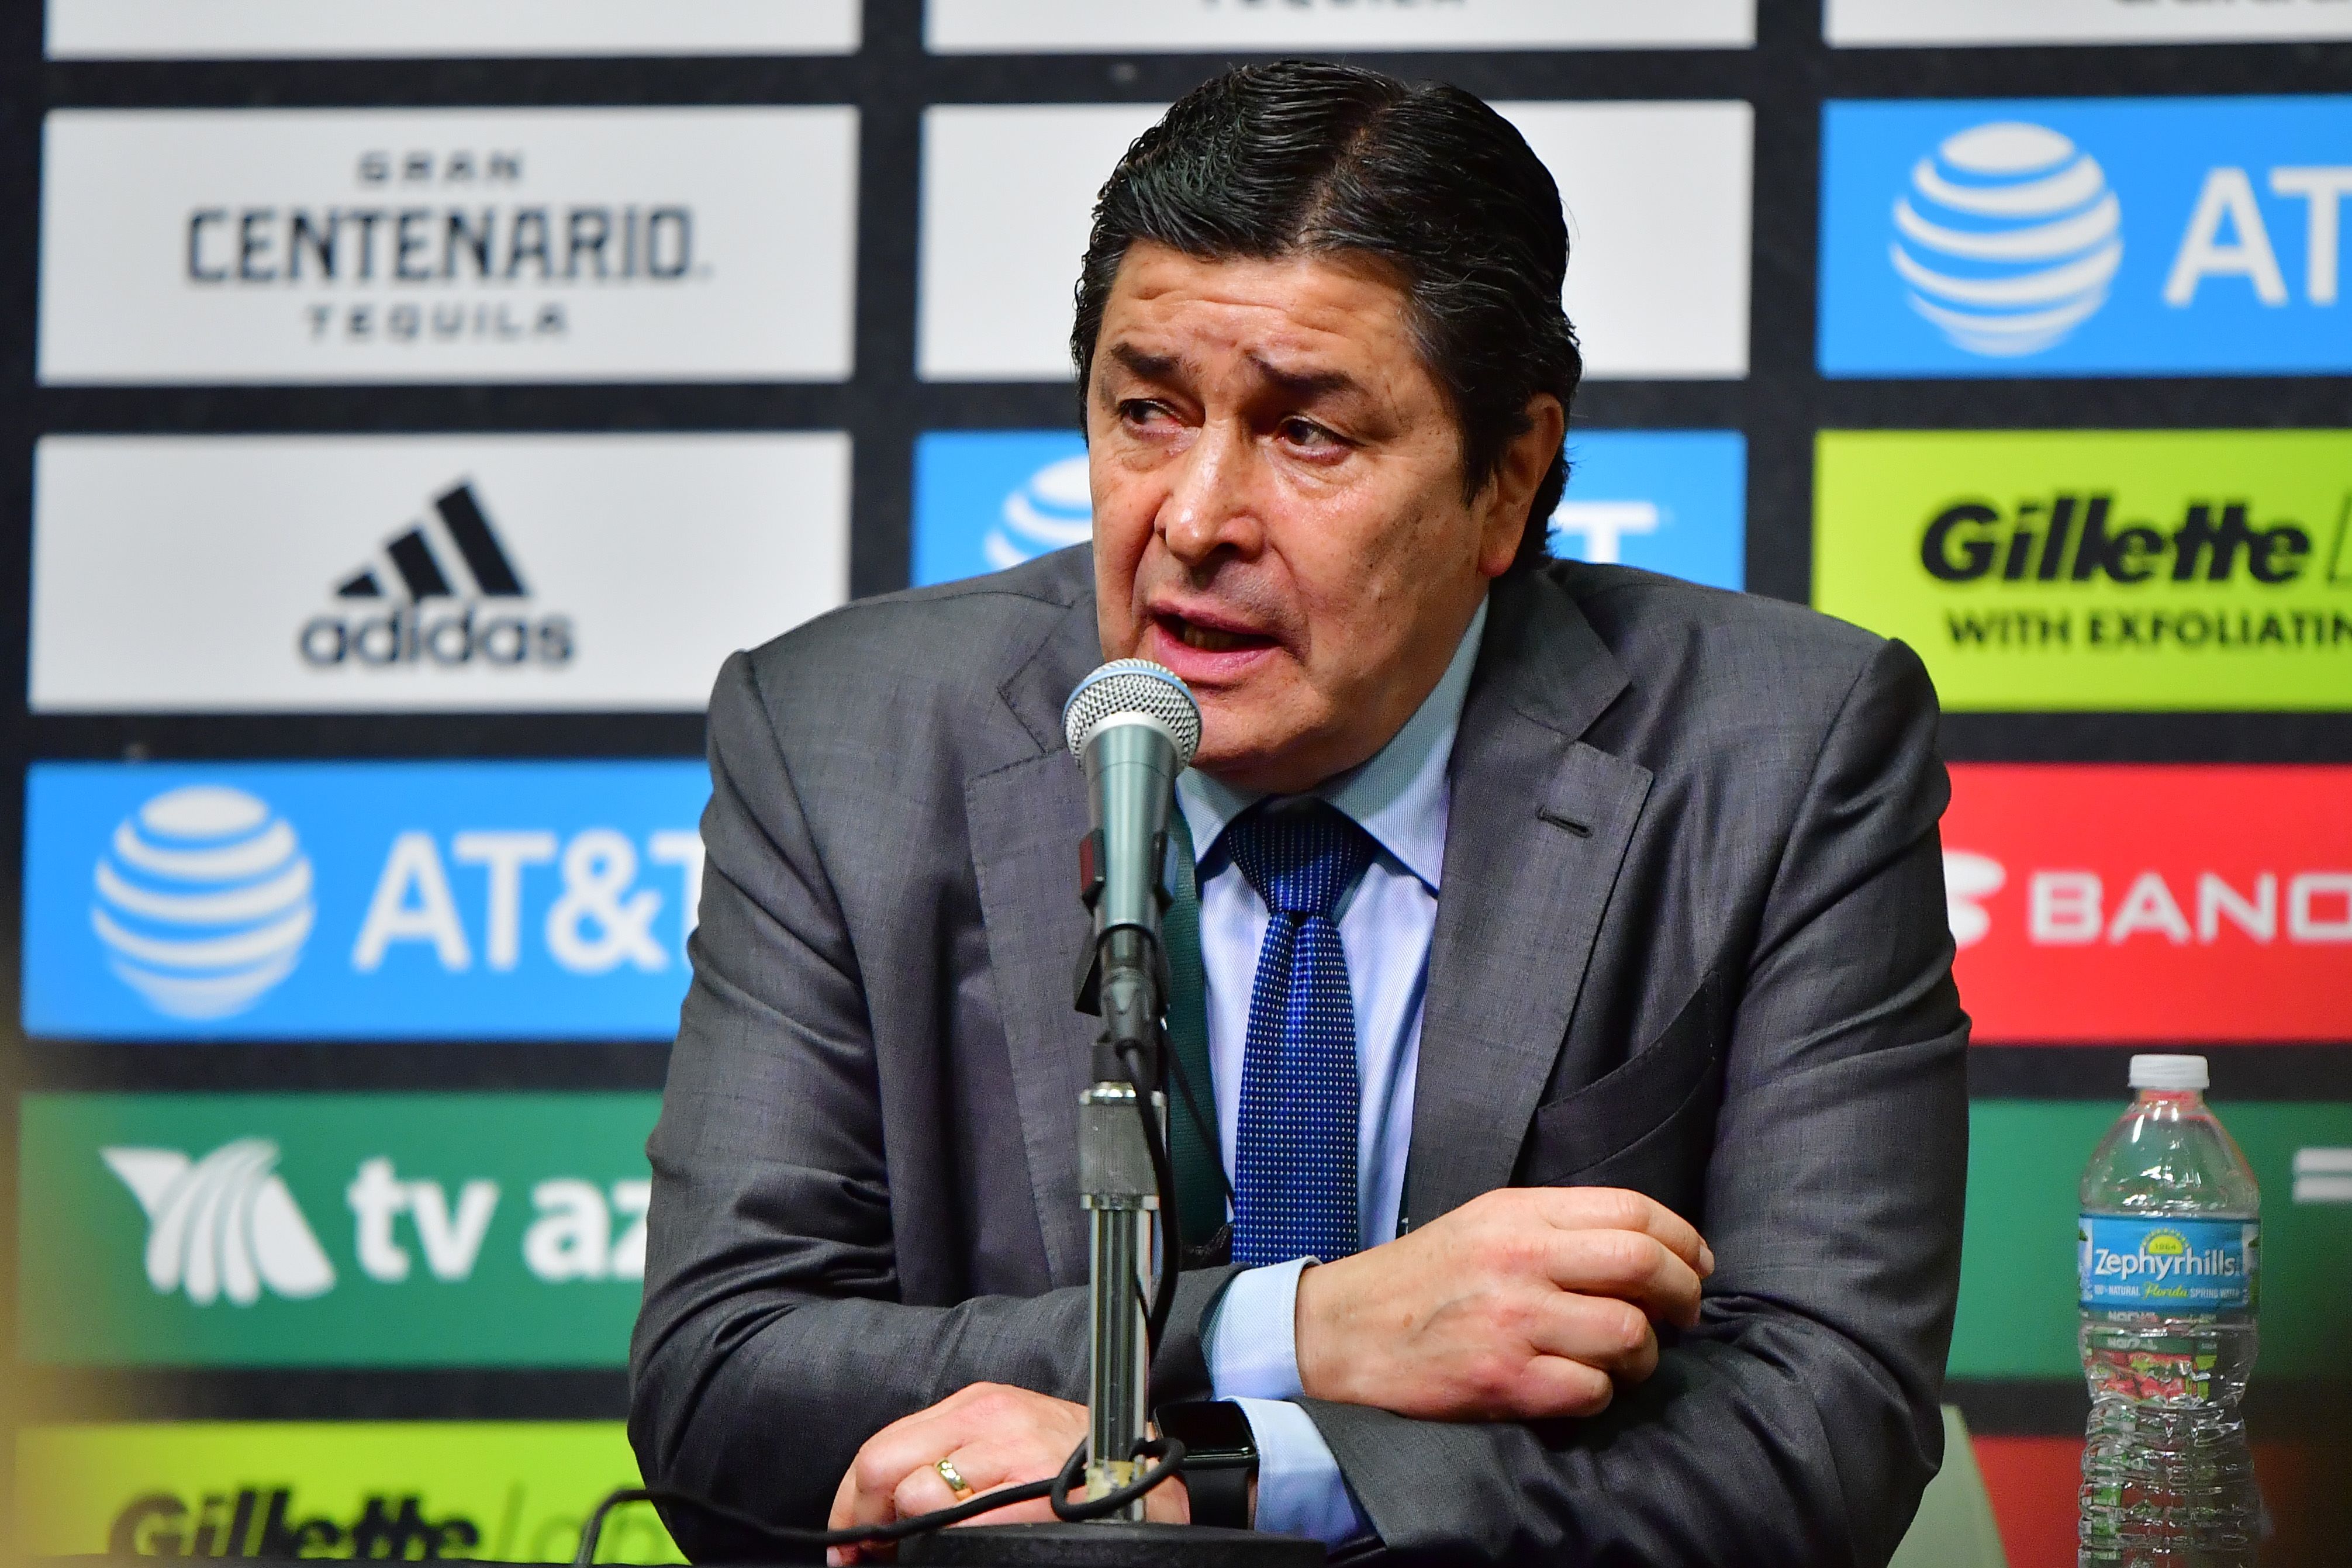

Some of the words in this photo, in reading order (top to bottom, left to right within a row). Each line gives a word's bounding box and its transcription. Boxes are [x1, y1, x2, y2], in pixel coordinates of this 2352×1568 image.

[357, 151, 522, 186] GRAN
[186, 206, 692, 284] CENTENARIO
[308, 303, 568, 343] TEQUILA
[1919, 493, 2313, 586] Gillette
[297, 599, 576, 668] adidas
[1946, 610, 2072, 648] WITH
[2087, 609, 2352, 650] EXFOLIATIN
[347, 1158, 499, 1280] tv
[2142, 1282, 2188, 1300] Florida
[107, 1486, 482, 1560] Gillette
